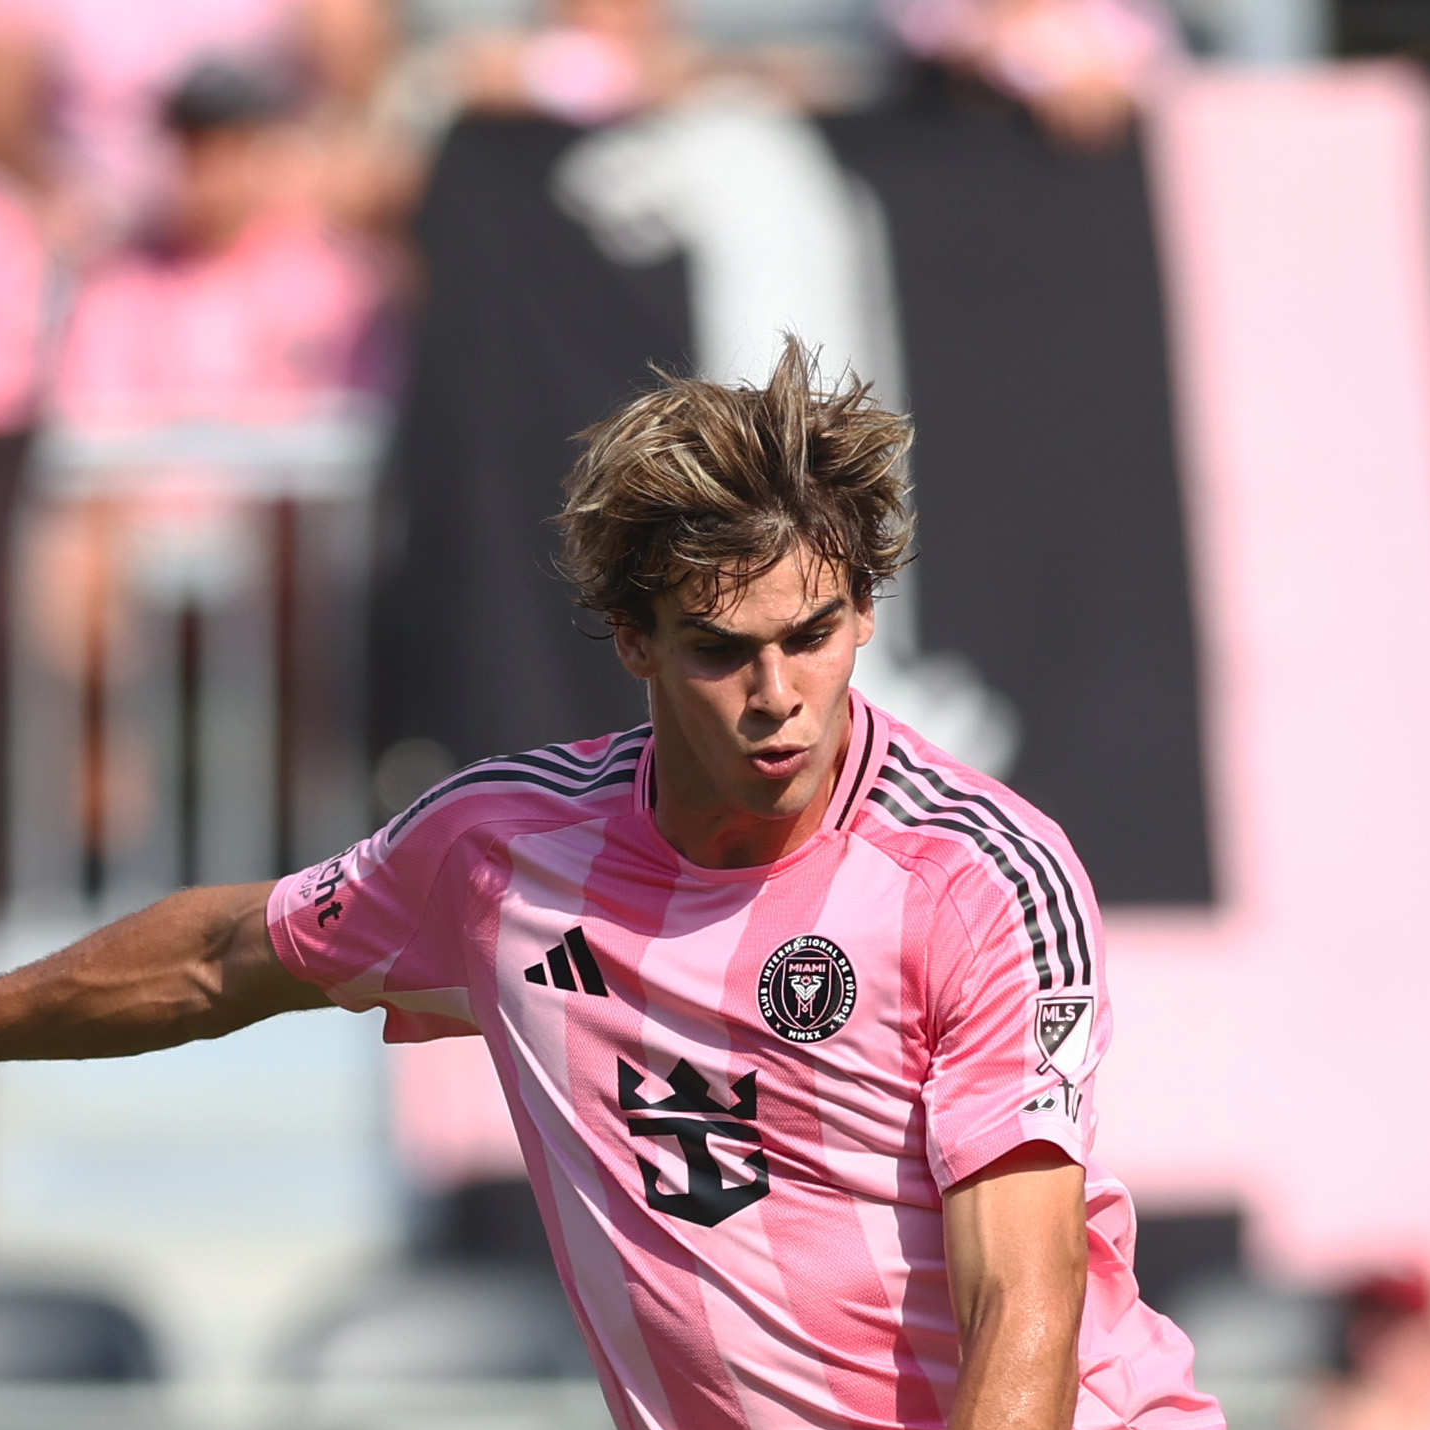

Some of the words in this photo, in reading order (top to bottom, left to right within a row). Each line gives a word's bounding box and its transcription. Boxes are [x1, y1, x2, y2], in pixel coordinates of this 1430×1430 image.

[762, 938, 838, 983] INTERNACIONAL
[788, 963, 826, 973] MIAMI
[838, 957, 850, 973] DE
[760, 987, 773, 1018] CLUB
[1042, 1005, 1076, 1023] MLS
[788, 1030, 822, 1041] MMXX
